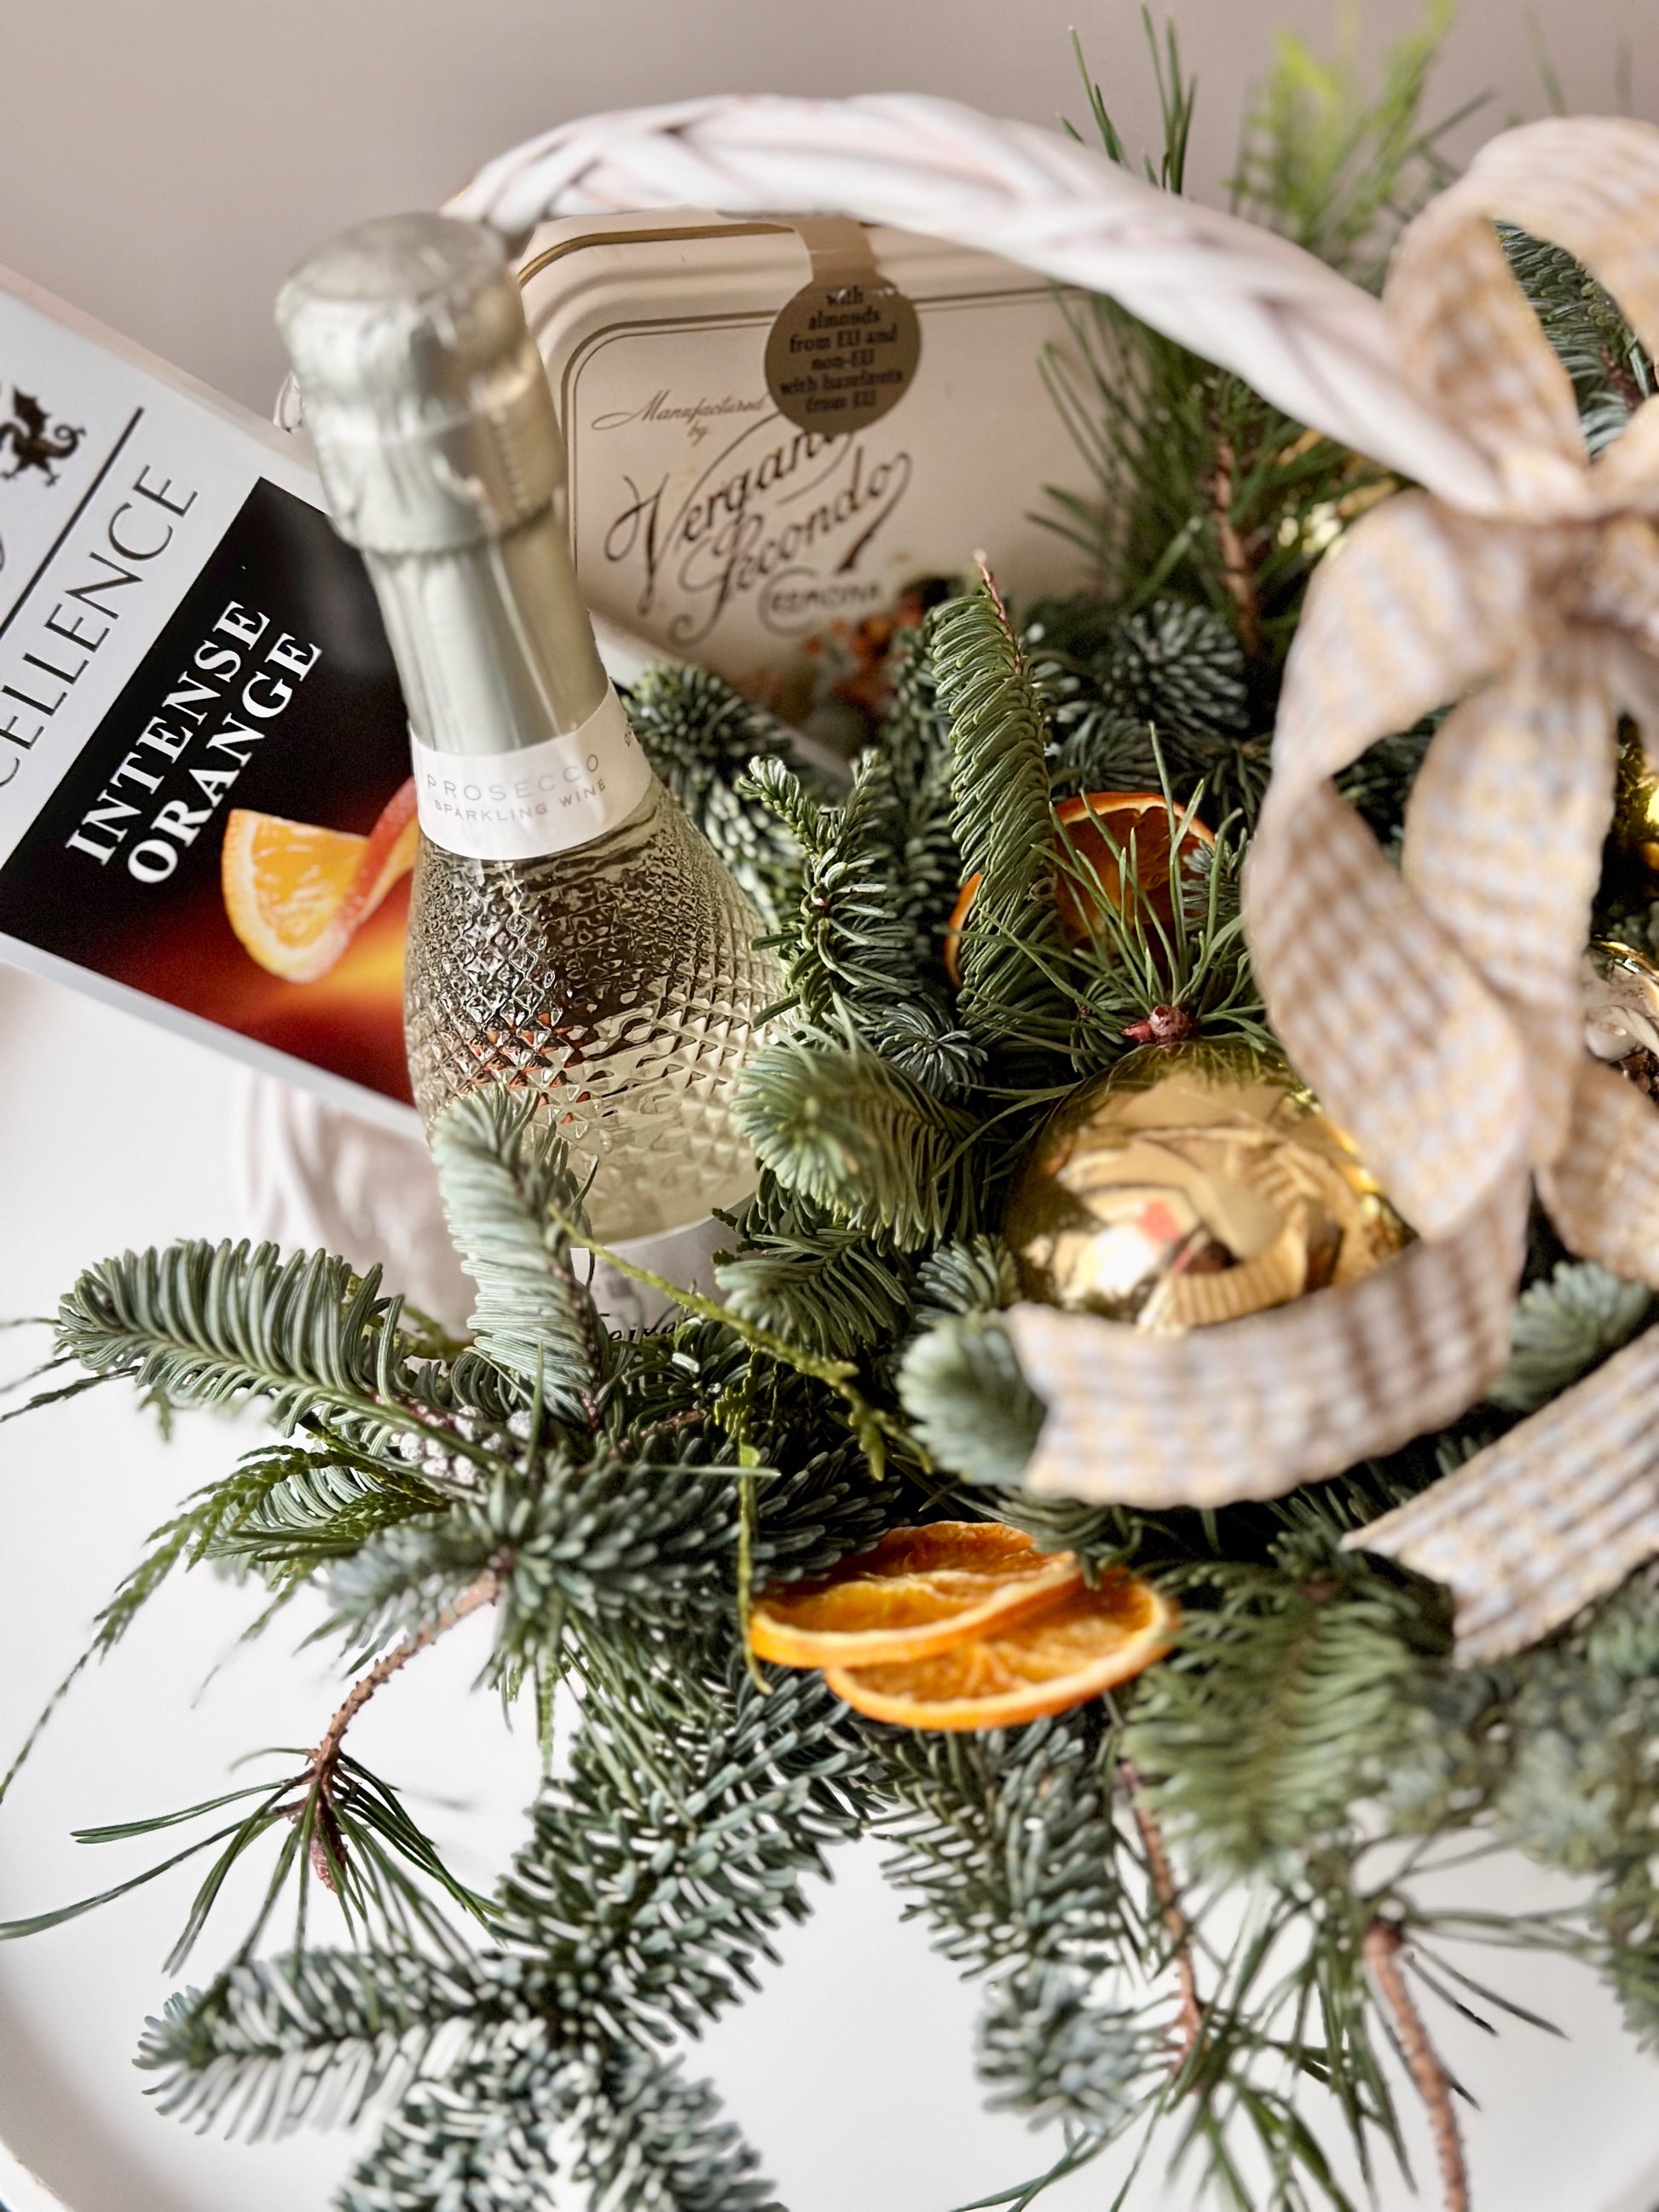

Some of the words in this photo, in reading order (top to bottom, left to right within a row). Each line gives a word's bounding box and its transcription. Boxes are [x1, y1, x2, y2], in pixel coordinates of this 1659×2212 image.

[808, 306, 880, 330] almonds
[789, 334, 830, 354] from
[836, 329, 860, 349] EU
[865, 323, 898, 344] and
[811, 349, 874, 371] non-EU
[779, 375, 818, 396] with
[805, 396, 847, 413] from
[853, 390, 876, 408] EU
[591, 388, 767, 430] Manufactured
[687, 423, 713, 448] by
[604, 413, 853, 617] Vergan
[66, 600, 271, 866] INTENSE
[127, 632, 323, 884] ORANGE
[426, 754, 599, 801] PROSECCO
[434, 800, 547, 823] SPARKLING
[559, 777, 606, 807] WINE
